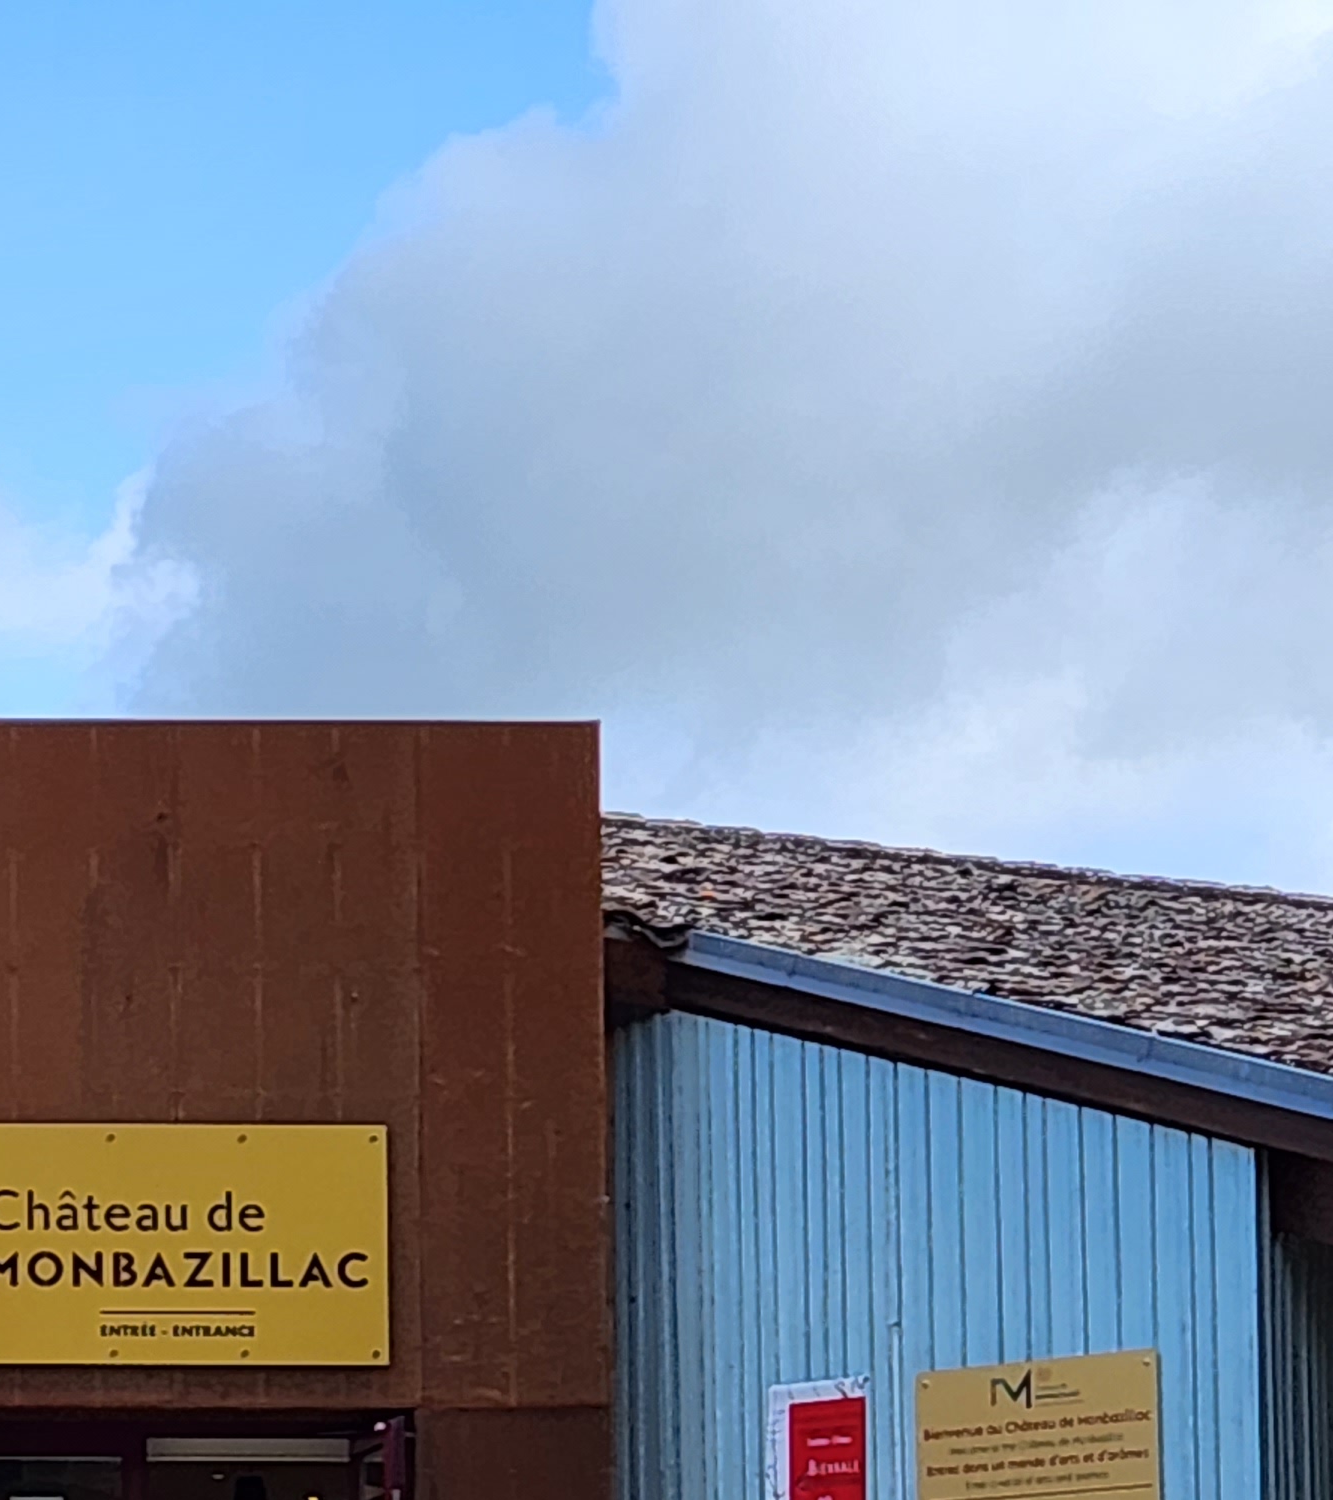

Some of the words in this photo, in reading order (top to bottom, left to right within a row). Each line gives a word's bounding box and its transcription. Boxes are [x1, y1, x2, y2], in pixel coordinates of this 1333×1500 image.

[207, 1190, 266, 1233] de
[99, 1321, 157, 1338] ENTRÉE
[172, 1324, 256, 1338] ENTRANCE
